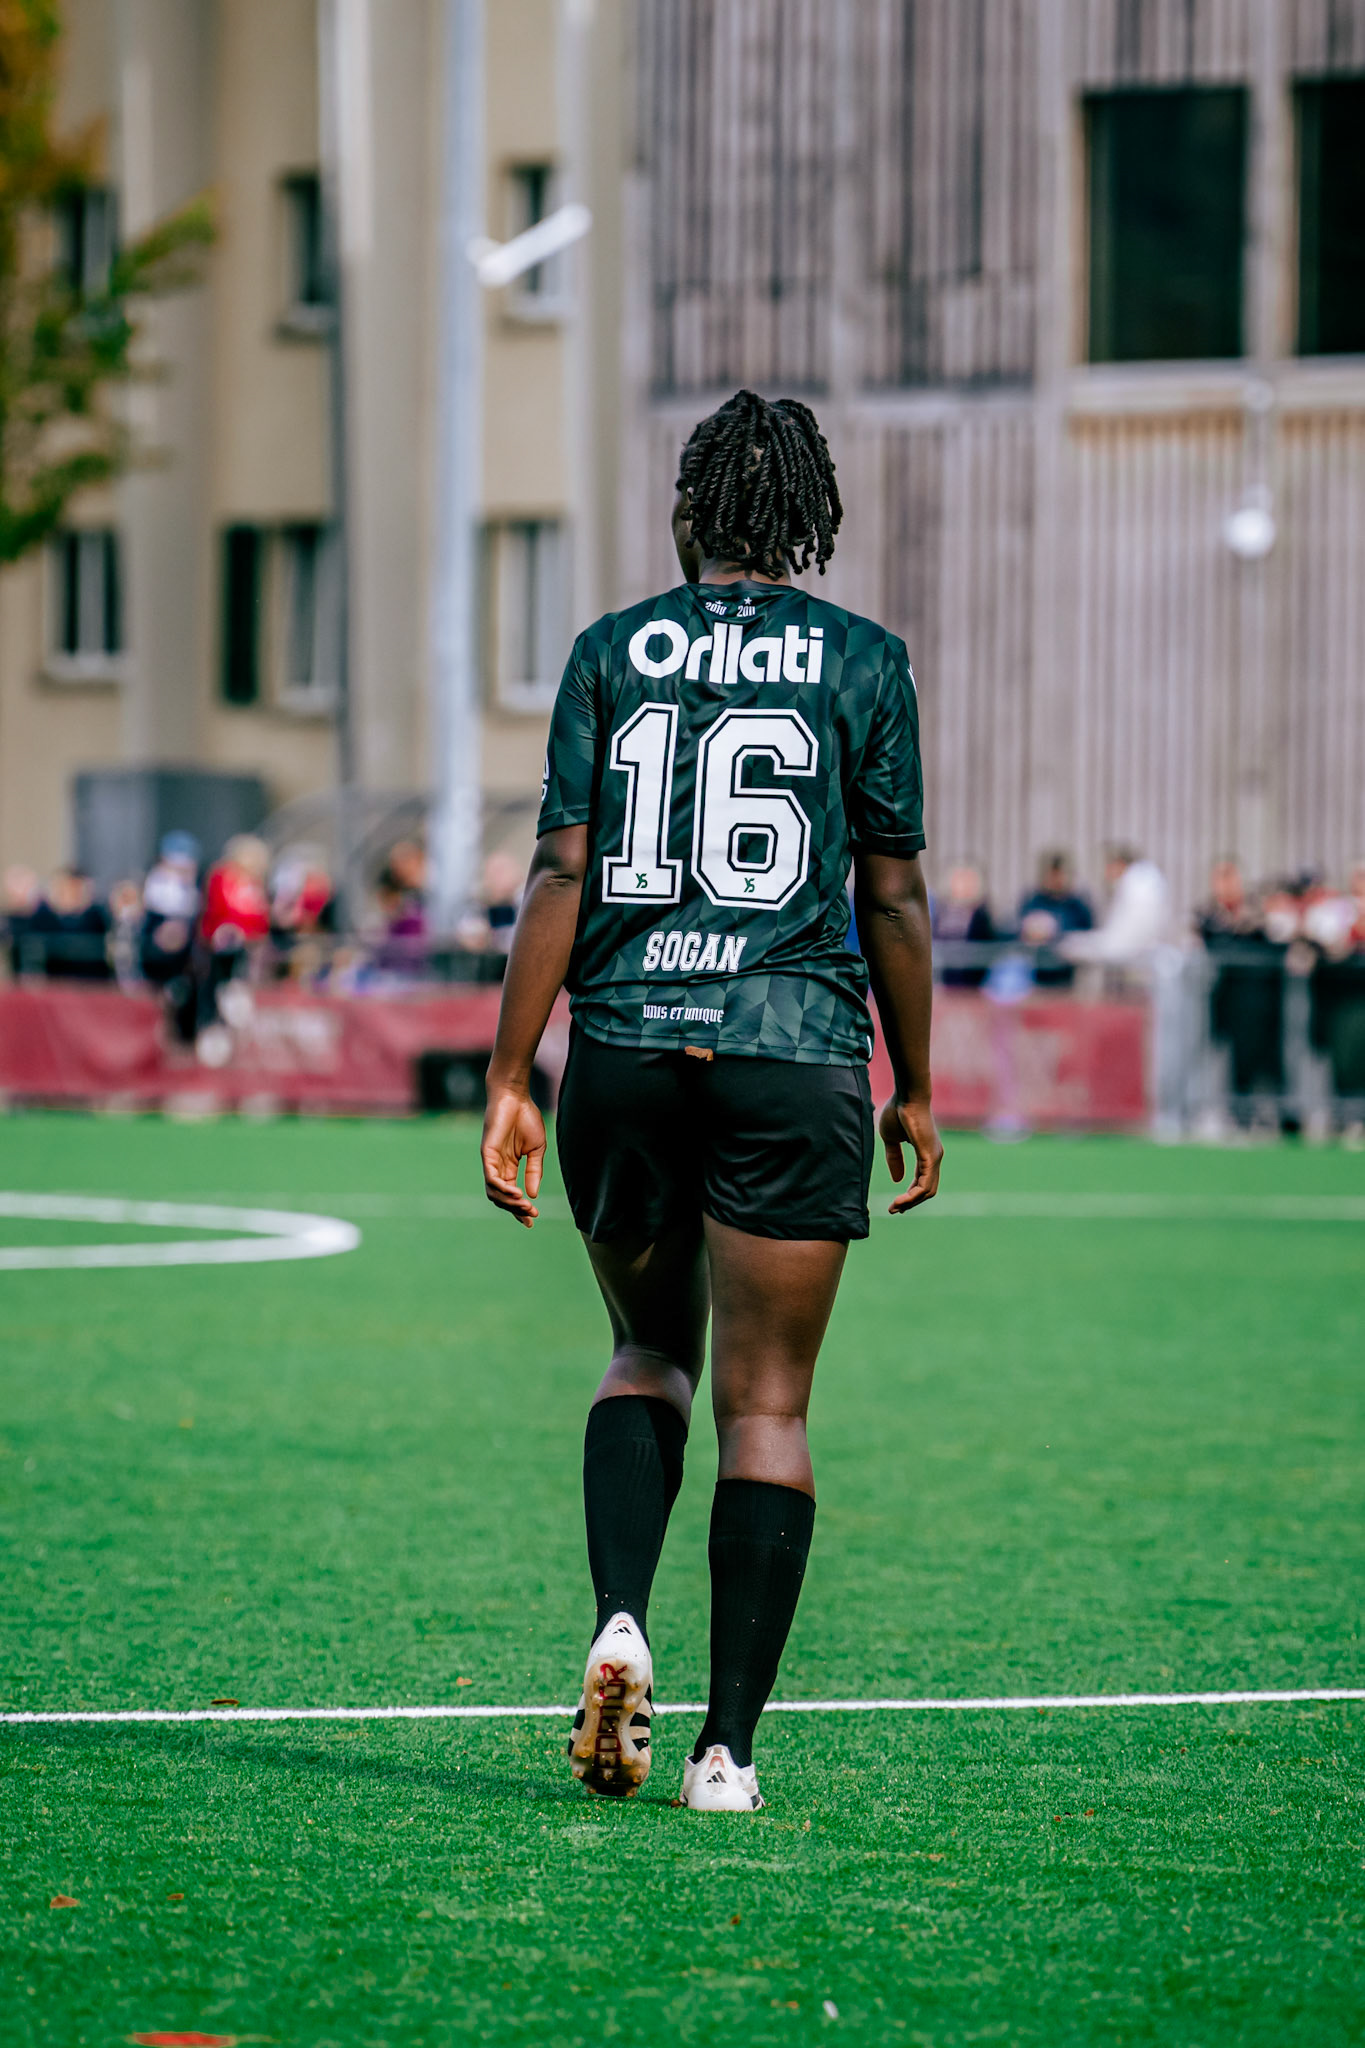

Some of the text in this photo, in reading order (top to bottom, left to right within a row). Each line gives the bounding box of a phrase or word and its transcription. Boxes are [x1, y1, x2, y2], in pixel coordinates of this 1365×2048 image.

[736, 605, 756, 617] 2011
[628, 618, 824, 684] Orllati
[602, 701, 820, 911] 16
[643, 931, 748, 973] SOGAN
[643, 1004, 724, 1024] UNIS ET UNIQUE
